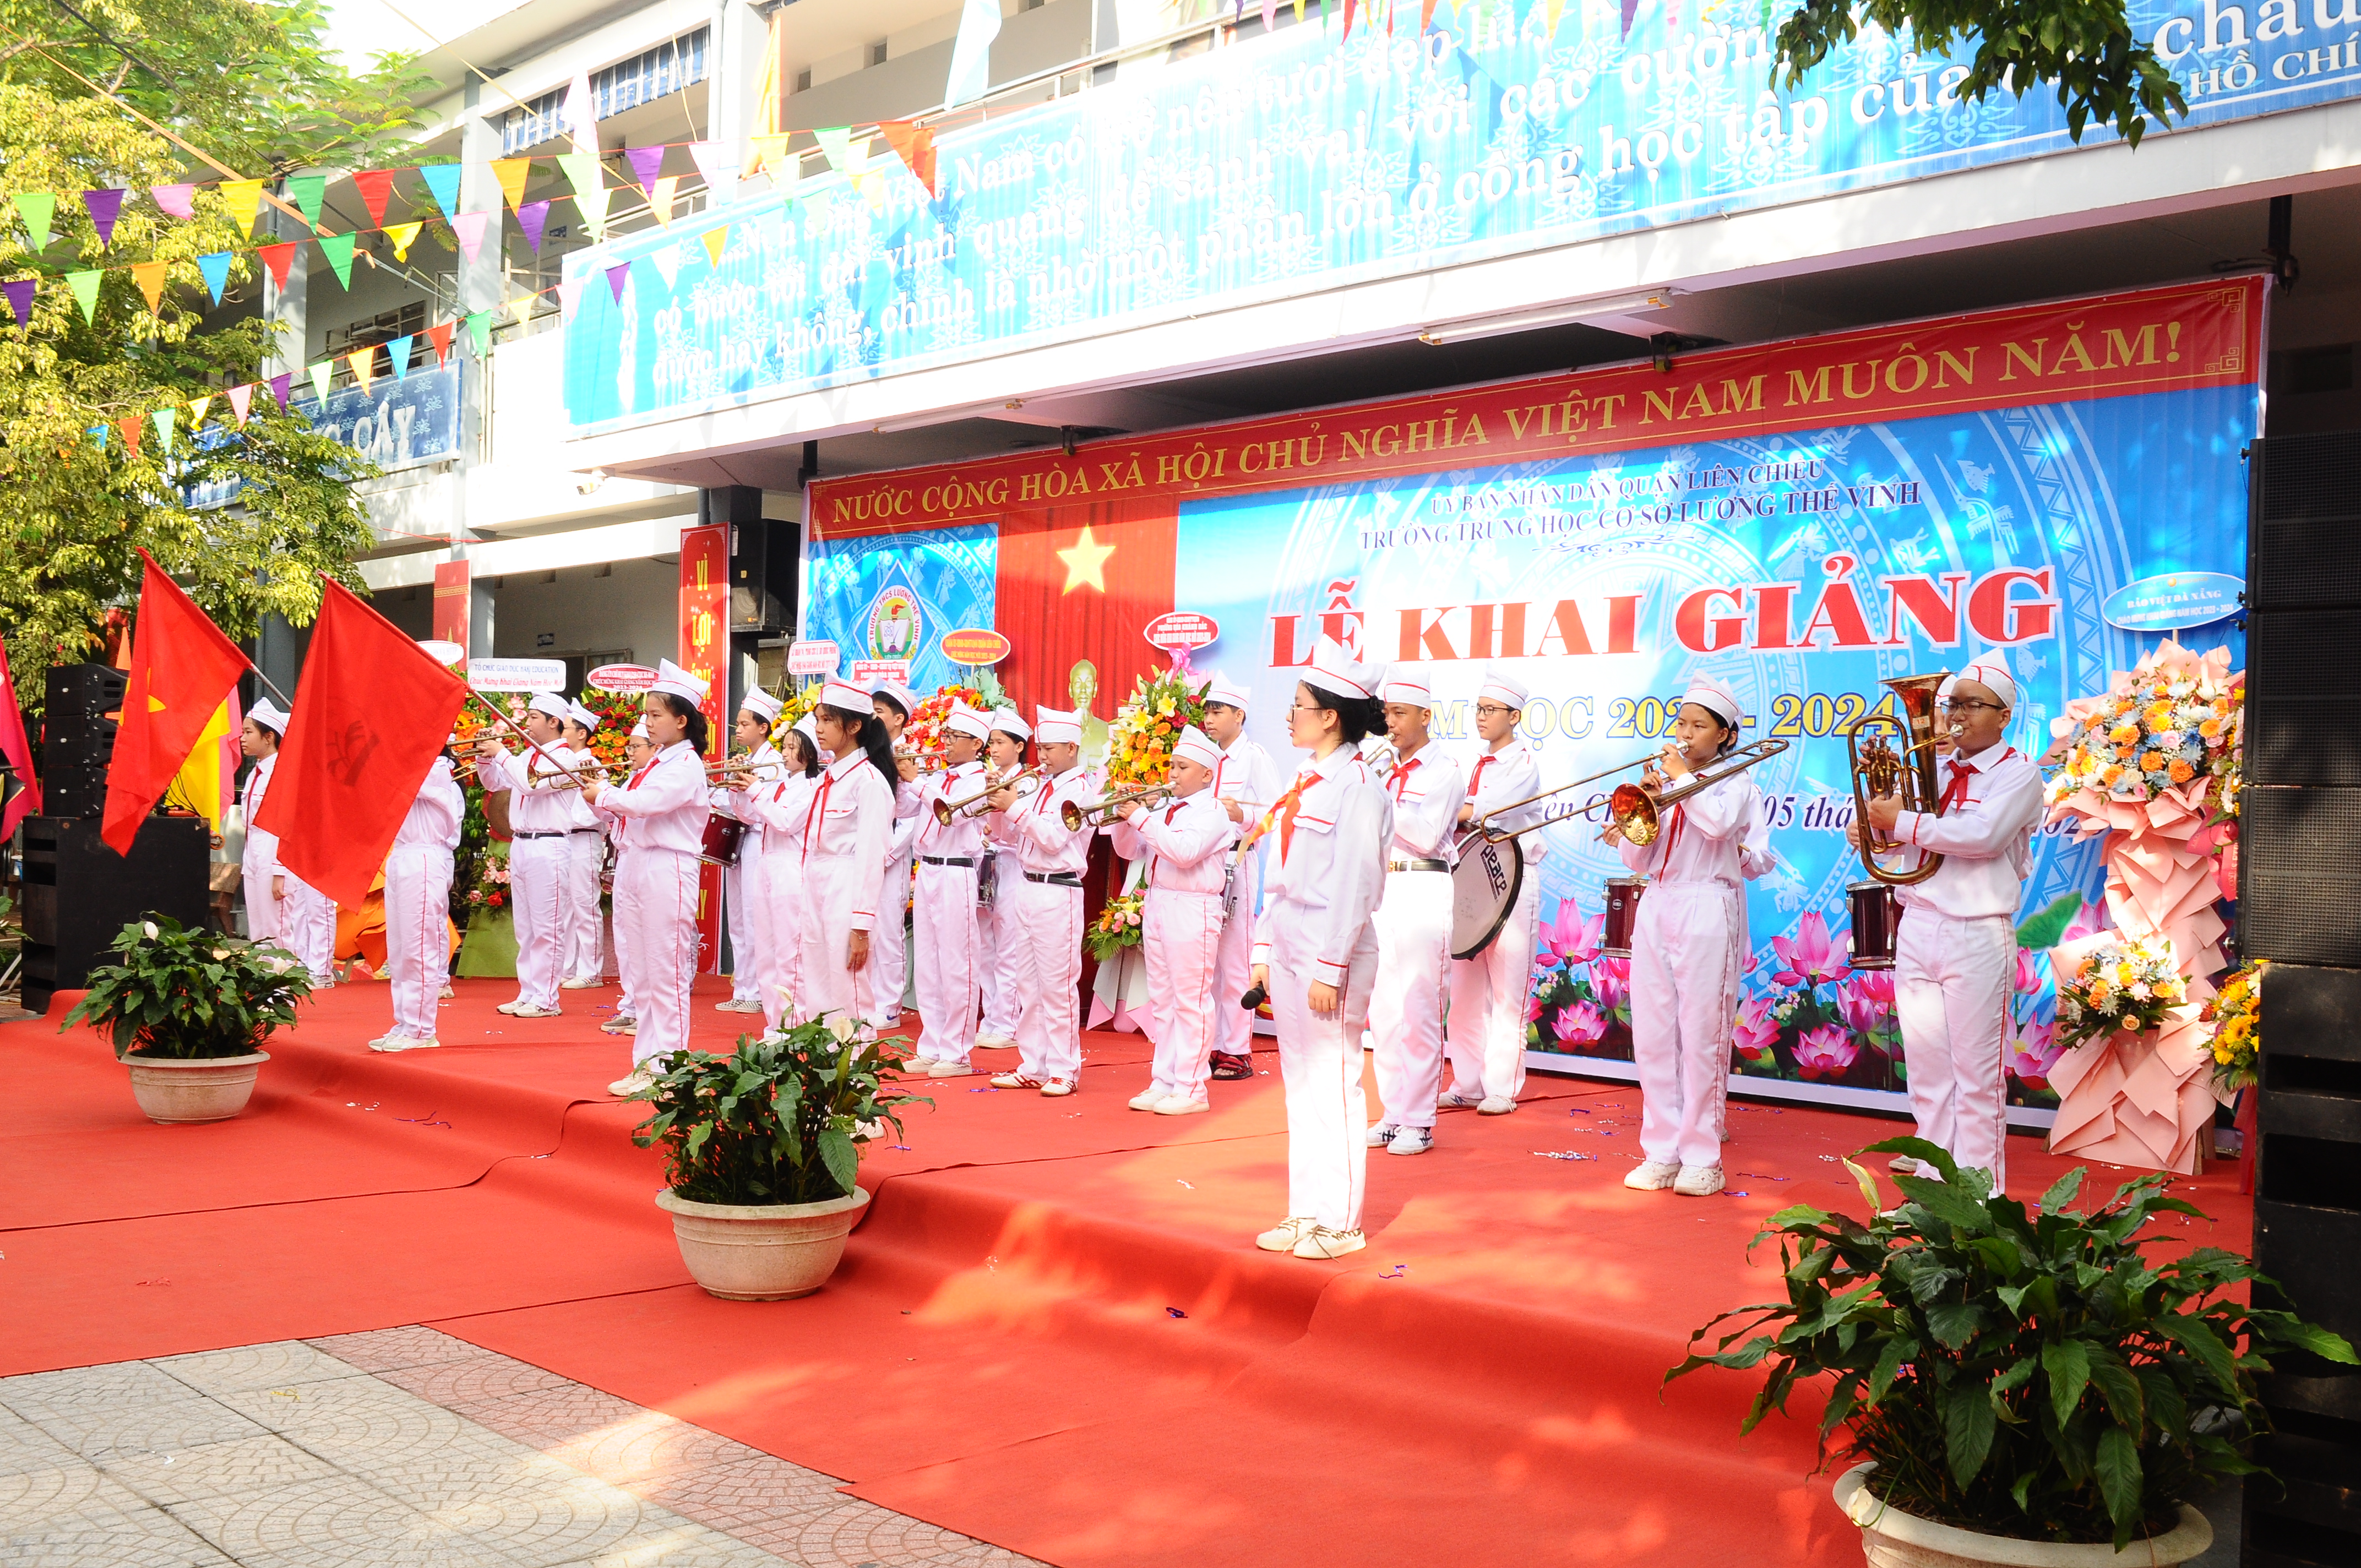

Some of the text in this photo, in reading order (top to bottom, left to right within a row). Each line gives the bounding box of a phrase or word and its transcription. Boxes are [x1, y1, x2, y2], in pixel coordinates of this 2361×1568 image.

[2188, 30, 2360, 99] HỒ CHÍ
[954, 151, 1036, 198] Nam
[1045, 122, 1085, 170] có
[1166, 84, 1245, 139] nên
[1257, 44, 1348, 111] tươi
[654, 294, 682, 333] có
[695, 277, 757, 325] bước
[884, 222, 956, 274] vinh
[973, 194, 1088, 260] quang
[1173, 137, 1274, 205] sánh
[1298, 110, 1367, 172] vai
[1394, 83, 1471, 148] với
[1500, 62, 1591, 122] các
[1620, 19, 1795, 95] cườn
[718, 334, 769, 371] hay
[775, 311, 873, 358] không,
[881, 276, 976, 332] chính
[984, 265, 1018, 312] là
[1026, 247, 1099, 303] nhờ
[1107, 229, 1185, 285] một
[1196, 194, 1308, 275] phần
[1320, 183, 1395, 239] lớn
[1409, 161, 1441, 214] ở
[1454, 144, 1584, 208] công
[1598, 122, 1704, 183] học
[1721, 89, 1830, 161] tập
[352, 400, 416, 453] CÂY
[833, 319, 2183, 524] NƯỚC CỘNG HÒA XÃ HỘI CHỦ NGHĨA VIỆT NAM MUÔN NĂM!
[1361, 481, 1922, 550] TRƯỜNG TRUNG HỌC CƠ SỞ LƯƠNG THẾ VINH
[1432, 455, 1825, 515] ỦY BAN NHÂN DÂN QUẬN LIÊN CHIỂU
[696, 553, 709, 591] VÌ
[692, 611, 712, 654] LỢI
[1268, 555, 2058, 668] LỄ KHAI GIẢNG
[1513, 696, 1593, 751] ỌC
[1606, 696, 1685, 739] 202
[1769, 692, 1899, 738] 2024
[1764, 796, 1795, 827] 05
